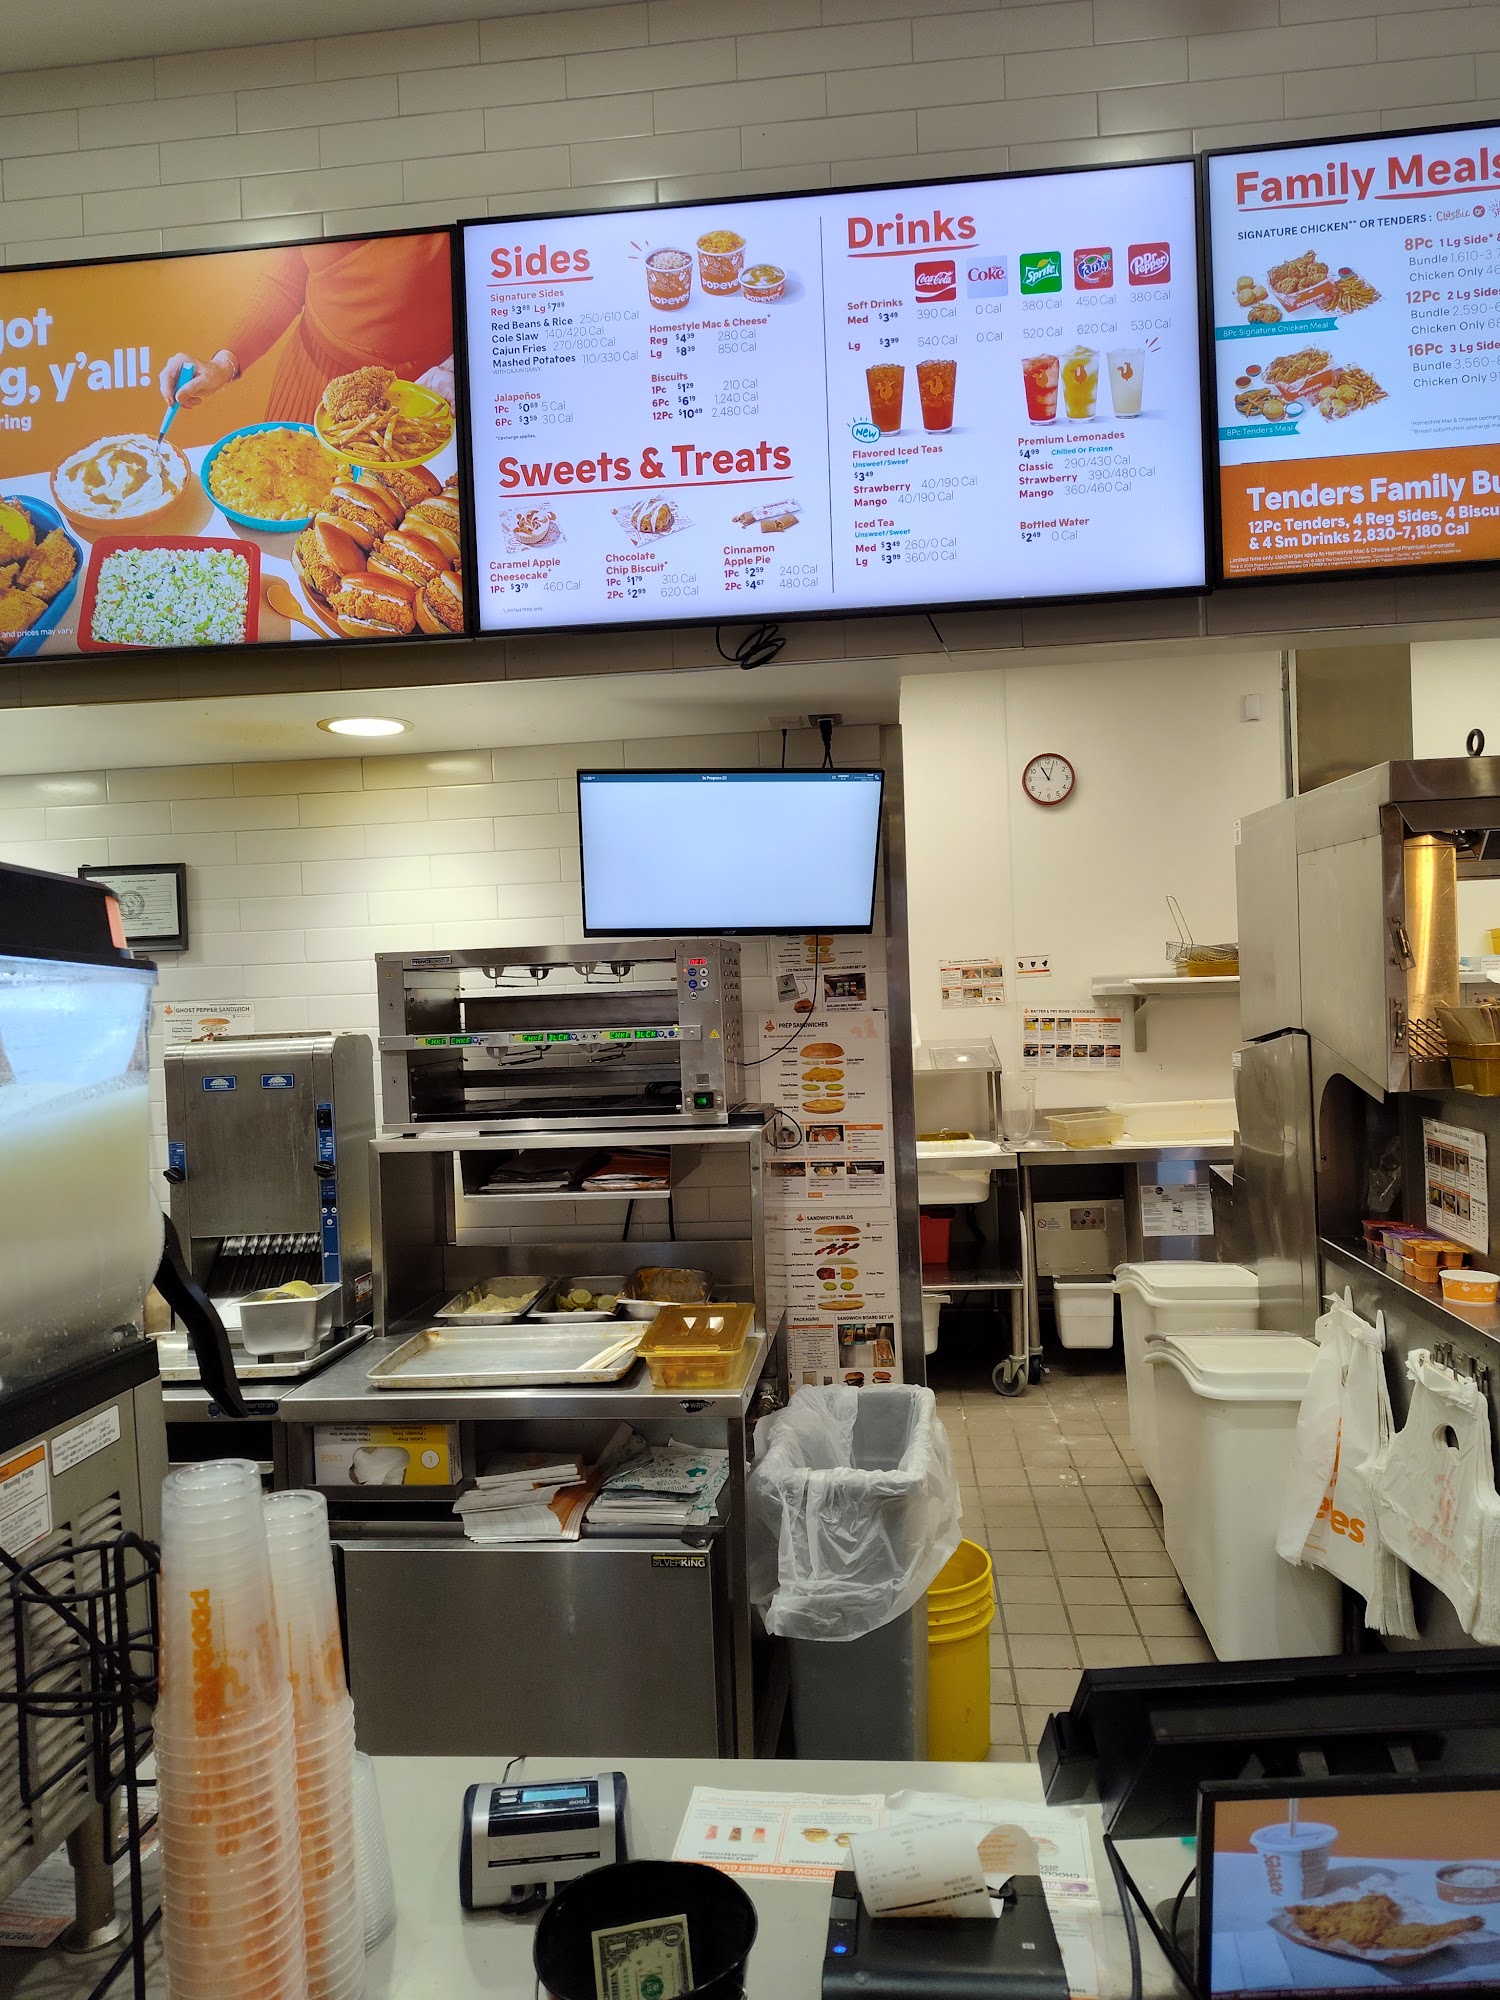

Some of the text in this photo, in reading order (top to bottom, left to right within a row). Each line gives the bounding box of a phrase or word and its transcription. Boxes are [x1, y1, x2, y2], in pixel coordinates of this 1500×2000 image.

[1236, 162, 1376, 205] Family
[848, 210, 976, 249] Drinks
[1238, 226, 1298, 240] SIGNATURE
[1359, 219, 1375, 228] OR
[1377, 214, 1427, 227] TENDERS
[1404, 237, 1433, 251] 8Pc
[1439, 238, 1444, 247] 1
[1447, 238, 1461, 248] Lg
[491, 244, 590, 279] Sides
[1077, 257, 1109, 278] Fanta
[968, 266, 1006, 282] Coke
[1025, 263, 1057, 283] Sprite
[490, 289, 564, 303] Signature Sides
[650, 292, 689, 305] POPEYES
[746, 293, 780, 302] POPEYES
[491, 308, 508, 317] Reg
[534, 305, 546, 314] Lg
[847, 299, 903, 311] Soft Drinks
[491, 310, 639, 331] Red Beans & Rice 250/610 Cal
[847, 315, 869, 325] Med
[917, 308, 938, 320] 390
[940, 307, 957, 318] Cal
[0, 308, 53, 354] ot
[491, 325, 604, 343] Cole Slaw 140/420 Cal
[649, 322, 700, 333] Homestyle
[702, 320, 722, 329] Mac
[723, 319, 730, 327] &
[1239, 325, 1276, 336] Signature
[1278, 323, 1309, 333] Chicken
[1310, 320, 1329, 330] Meal
[650, 336, 668, 346] Reg
[718, 330, 738, 341] 280
[740, 329, 756, 339] Cal
[492, 337, 616, 356] Cajun Fries 270/800 Cal
[493, 350, 638, 368] Mashed Potatoes 110/330 Cal
[49, 346, 151, 402] y'all!
[651, 372, 688, 383] Biscuits
[651, 386, 667, 394] 1Pc
[723, 379, 740, 391] 210
[741, 378, 758, 389] Cal
[494, 392, 541, 403] Jalapeños
[855, 427, 877, 439] New
[1018, 431, 1125, 446] Premium Lemonades
[852, 445, 943, 459] Flavored Iced Teas
[499, 441, 791, 488] Sweets & Treats
[852, 458, 909, 468] Unsweet/Sweet
[1018, 454, 1131, 472] Classic 290/430 Cal
[853, 476, 977, 494] Strawberry 40/190 Cal
[1246, 483, 1365, 511] Tenders
[1370, 473, 1466, 502] Family
[854, 519, 894, 529] Iced Tea
[1020, 518, 1090, 530] Bottled Water
[1248, 520, 1282, 534] 12Pc
[1284, 516, 1350, 531] Tenders,
[1353, 515, 1362, 527] 4
[1366, 512, 1394, 526] Reg
[1398, 509, 1443, 523] Sides,
[1446, 506, 1456, 519] 4
[1249, 522, 1469, 550] & 4 Sm Drinks 2,830-7,180 Cal
[605, 552, 655, 563] Chocolate
[723, 545, 775, 555] Cinnamon
[489, 558, 561, 570] Caramel Apple
[724, 555, 771, 568] Apple Pie
[606, 565, 629, 576] Chip
[2, 626, 75, 639] and prices may vary.
[738, 1865, 783, 1875] CASHIER
